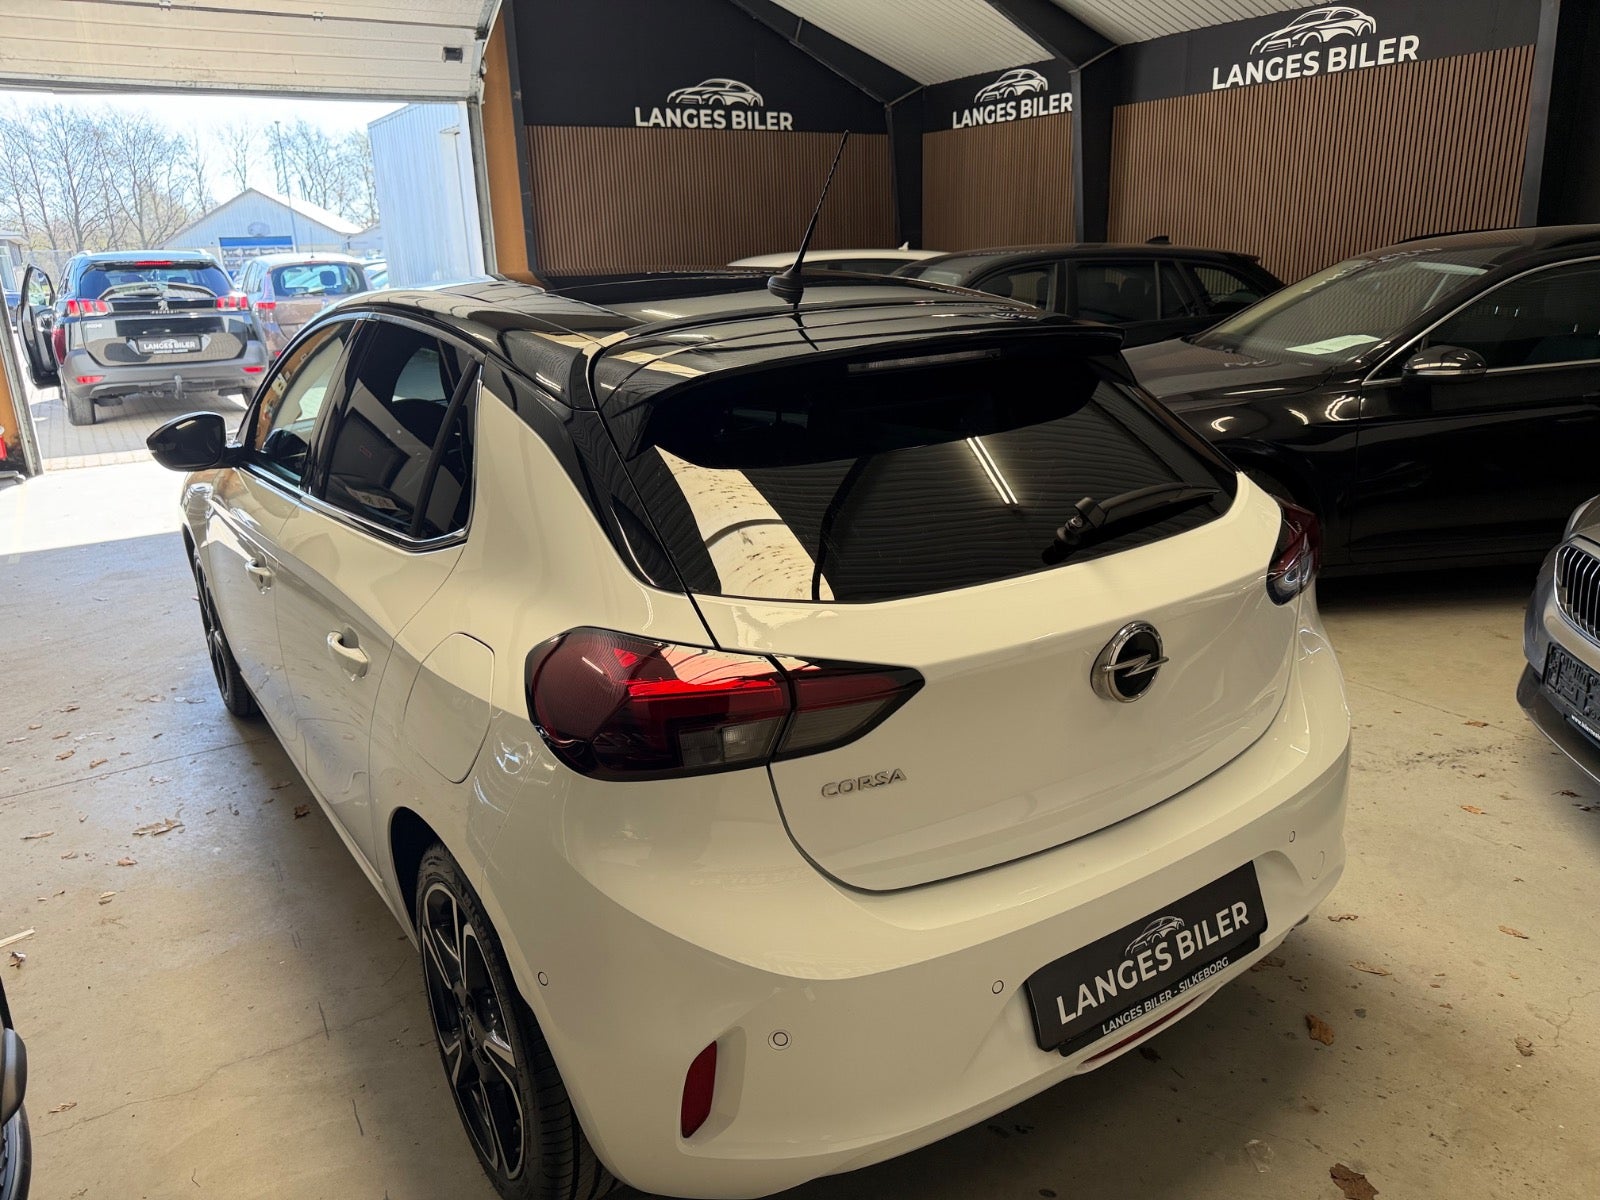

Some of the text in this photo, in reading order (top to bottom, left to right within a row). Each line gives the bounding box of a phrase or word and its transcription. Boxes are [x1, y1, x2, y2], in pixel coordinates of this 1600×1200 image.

[1212, 35, 1420, 90] LANGES BILER
[634, 107, 793, 131] LANGES BILER
[952, 92, 1073, 129] LANGES BILER
[143, 342, 173, 350] LANGES
[821, 768, 907, 798] CORSA
[1056, 901, 1250, 1025] LANGES BILER
[1102, 1005, 1143, 1035] LANGES
[1143, 990, 1173, 1014] BILER
[1178, 956, 1229, 996] SILKEBORG
